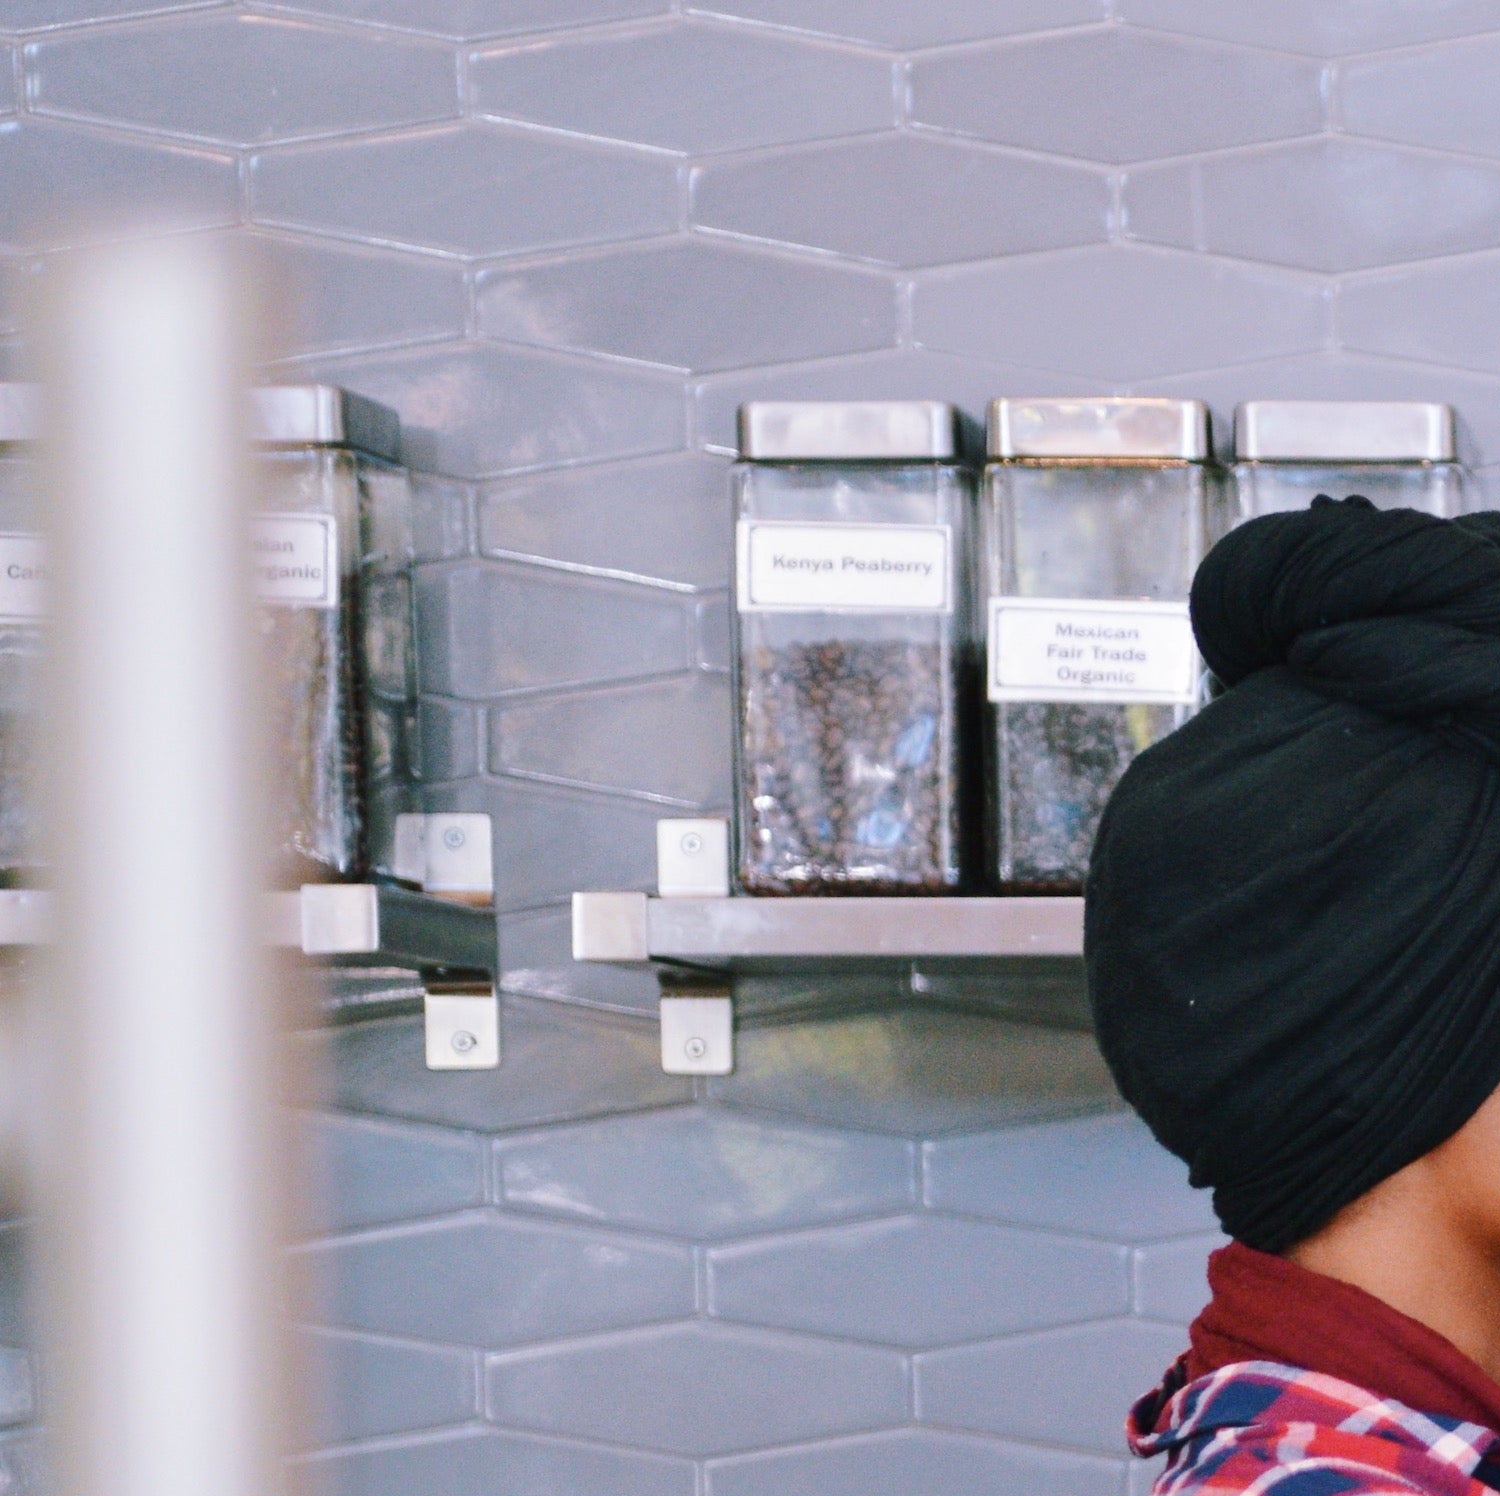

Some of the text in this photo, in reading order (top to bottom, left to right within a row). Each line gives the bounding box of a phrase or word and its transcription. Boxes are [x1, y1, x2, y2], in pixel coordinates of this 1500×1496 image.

[772, 554, 933, 576] Kenya Peaberry
[1055, 622, 1140, 640] Mexican
[1047, 643, 1147, 662] Fair Trade
[1056, 666, 1136, 685] Organic
